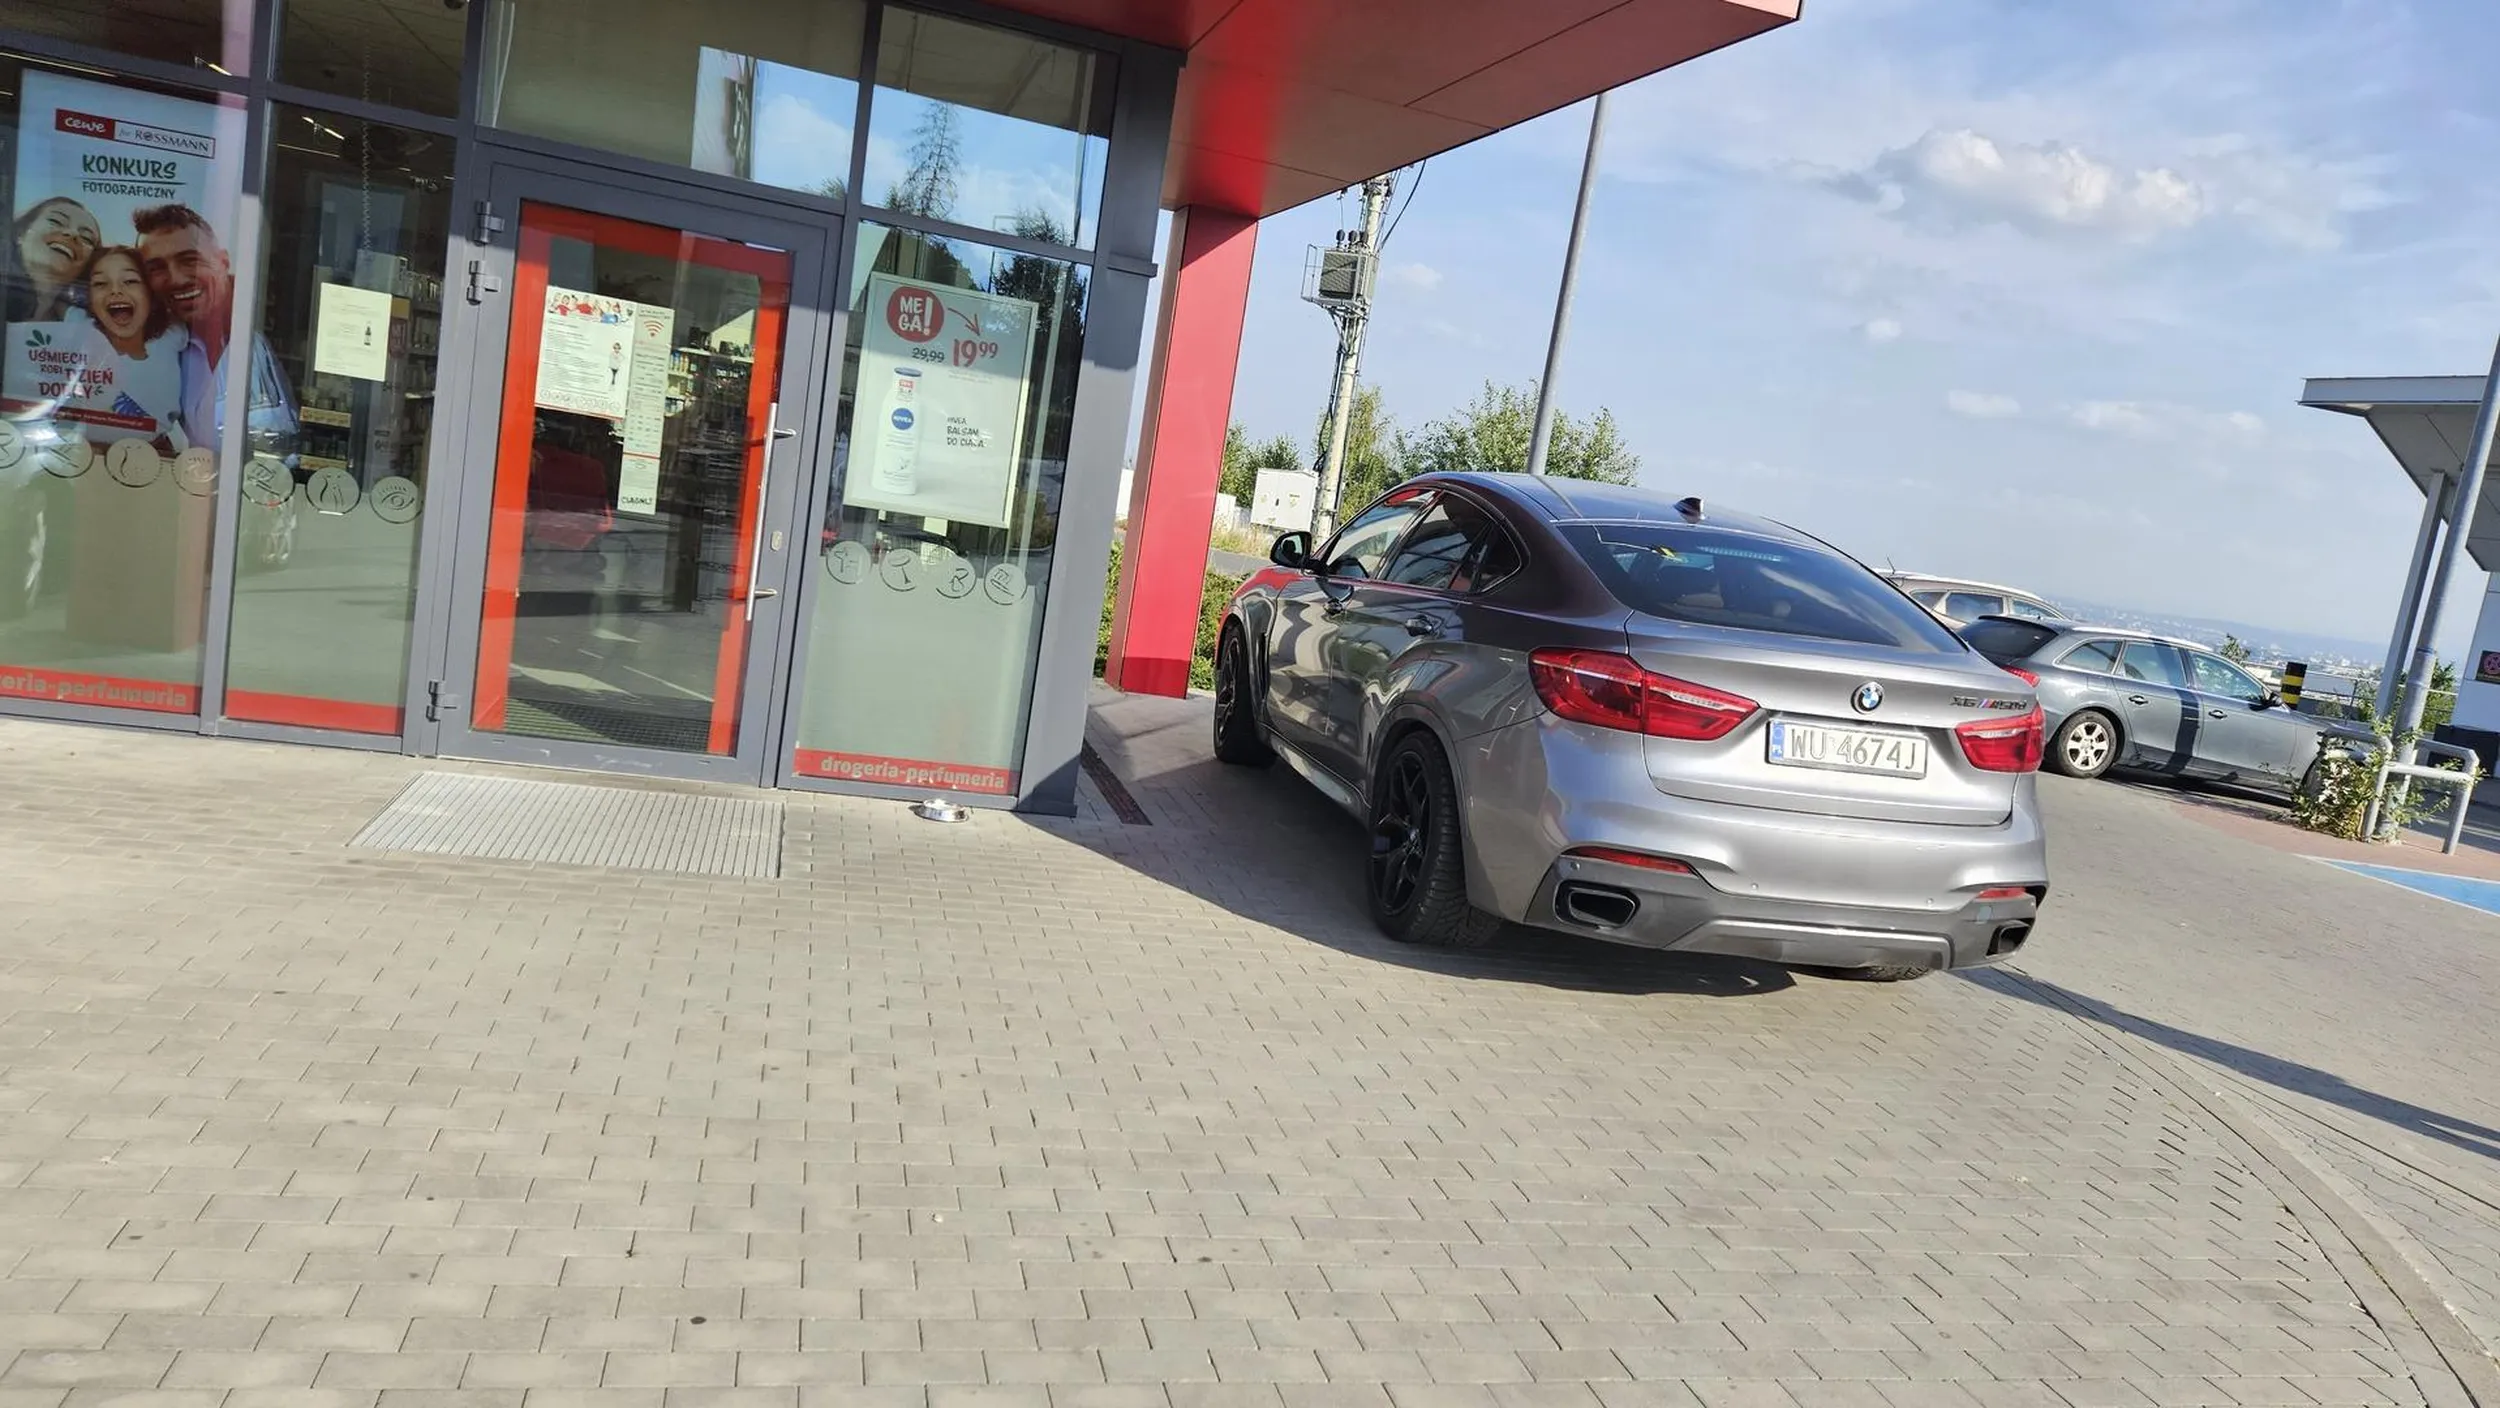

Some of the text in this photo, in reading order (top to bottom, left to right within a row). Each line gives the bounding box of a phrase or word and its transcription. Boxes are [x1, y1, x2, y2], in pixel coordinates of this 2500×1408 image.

[63, 117, 106, 133] cewe
[134, 129, 210, 153] ROSSMANN
[82, 153, 177, 179] KONKURS
[82, 181, 176, 199] FOTOGRAFICZNY
[0, 671, 188, 708] eria-perfumeria
[1791, 727, 1917, 771] WU 4674J
[820, 755, 1006, 789] drogeria-perfumeria
